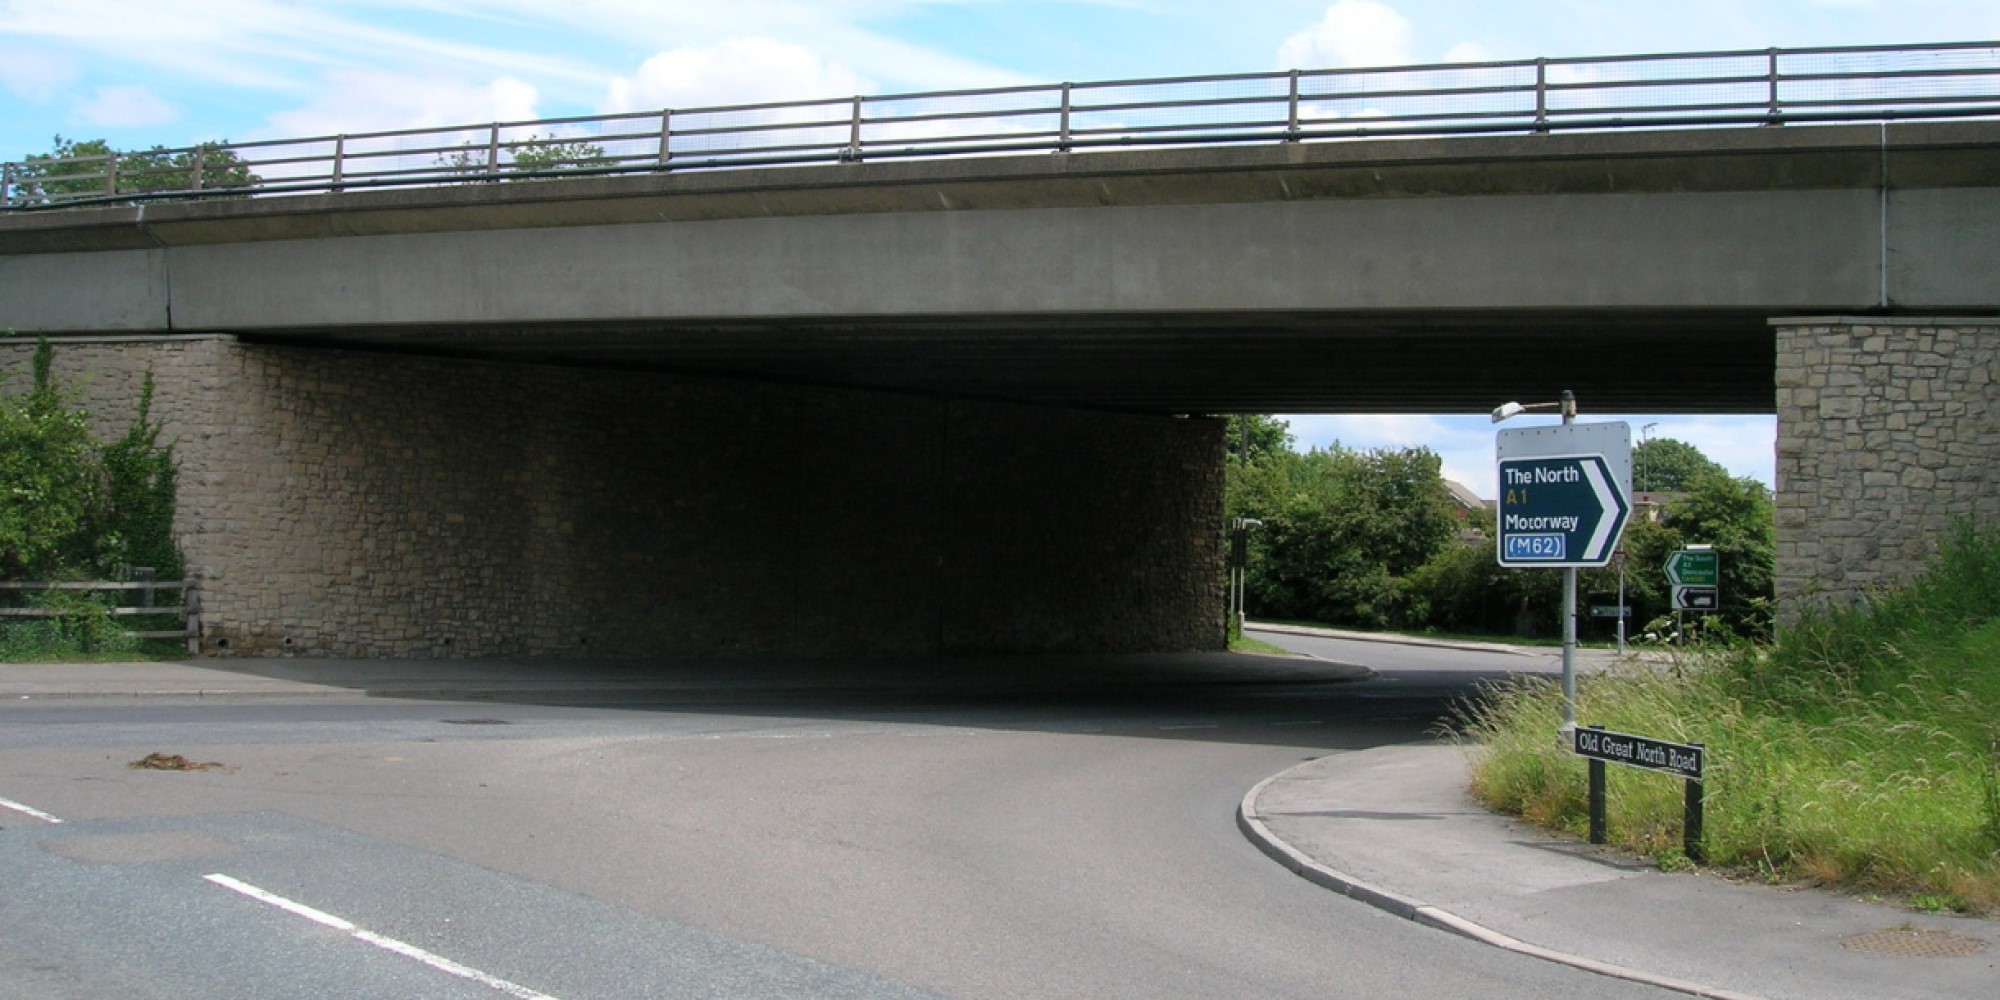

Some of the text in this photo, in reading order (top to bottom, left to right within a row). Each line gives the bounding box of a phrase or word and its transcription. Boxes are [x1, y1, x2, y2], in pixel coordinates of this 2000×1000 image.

[1505, 466, 1579, 484] The North
[1506, 488, 1528, 504] A1
[1505, 514, 1579, 532] Motorway
[1509, 537, 1560, 555] (M62)
[1579, 732, 1696, 771] Old Great North Road
